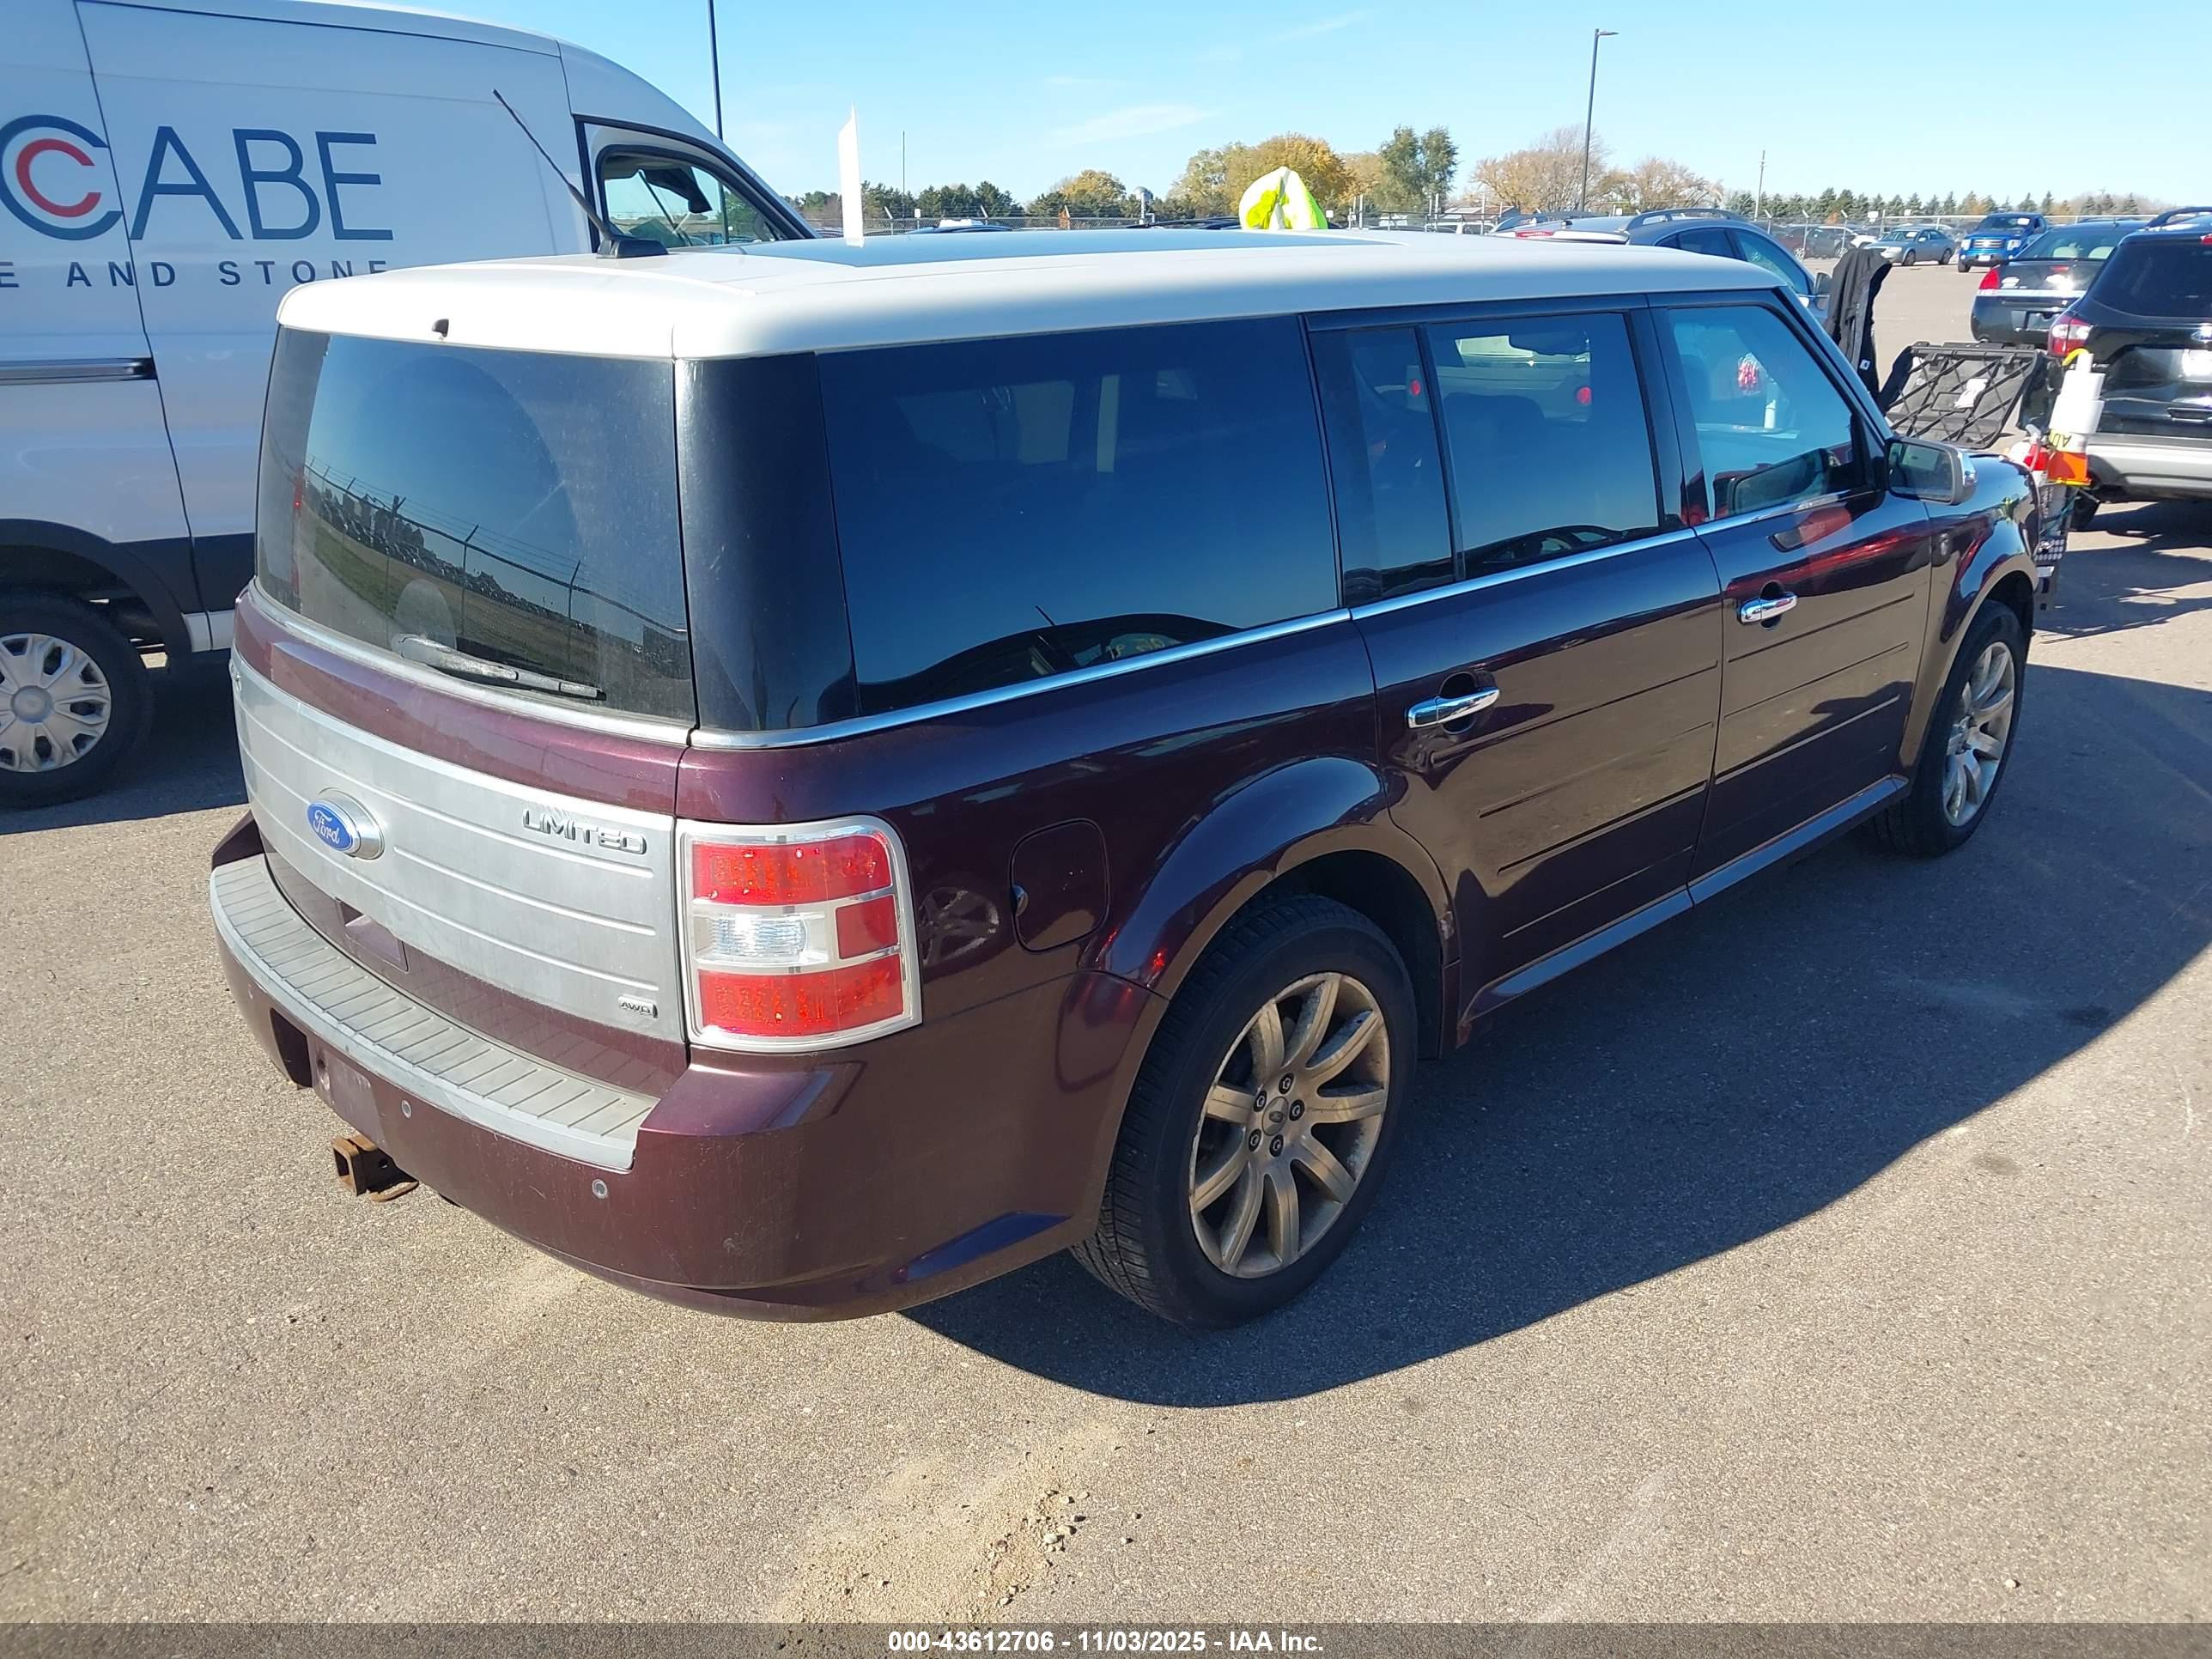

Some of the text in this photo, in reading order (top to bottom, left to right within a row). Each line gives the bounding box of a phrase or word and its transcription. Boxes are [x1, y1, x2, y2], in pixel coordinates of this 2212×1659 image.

[66, 261, 176, 288] AND
[313, 810, 341, 845] Ford
[522, 808, 647, 855] LIMITED
[620, 1001, 652, 1016] AWD
